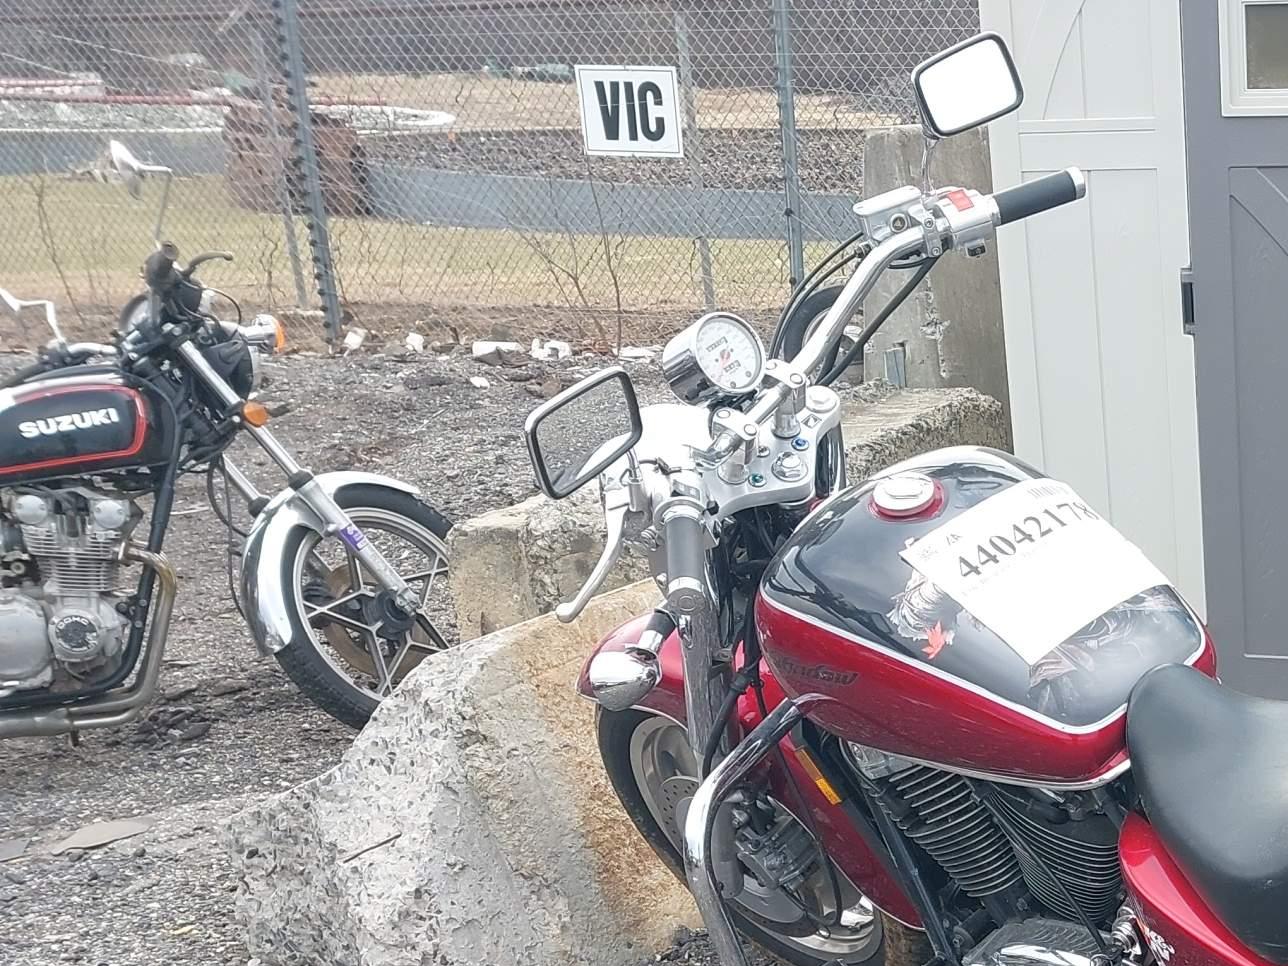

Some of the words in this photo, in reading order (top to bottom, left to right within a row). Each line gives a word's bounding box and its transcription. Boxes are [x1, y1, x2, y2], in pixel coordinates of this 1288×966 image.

[593, 80, 666, 142] VIC
[18, 407, 120, 439] SUZUKI
[958, 501, 1101, 578] 44042178
